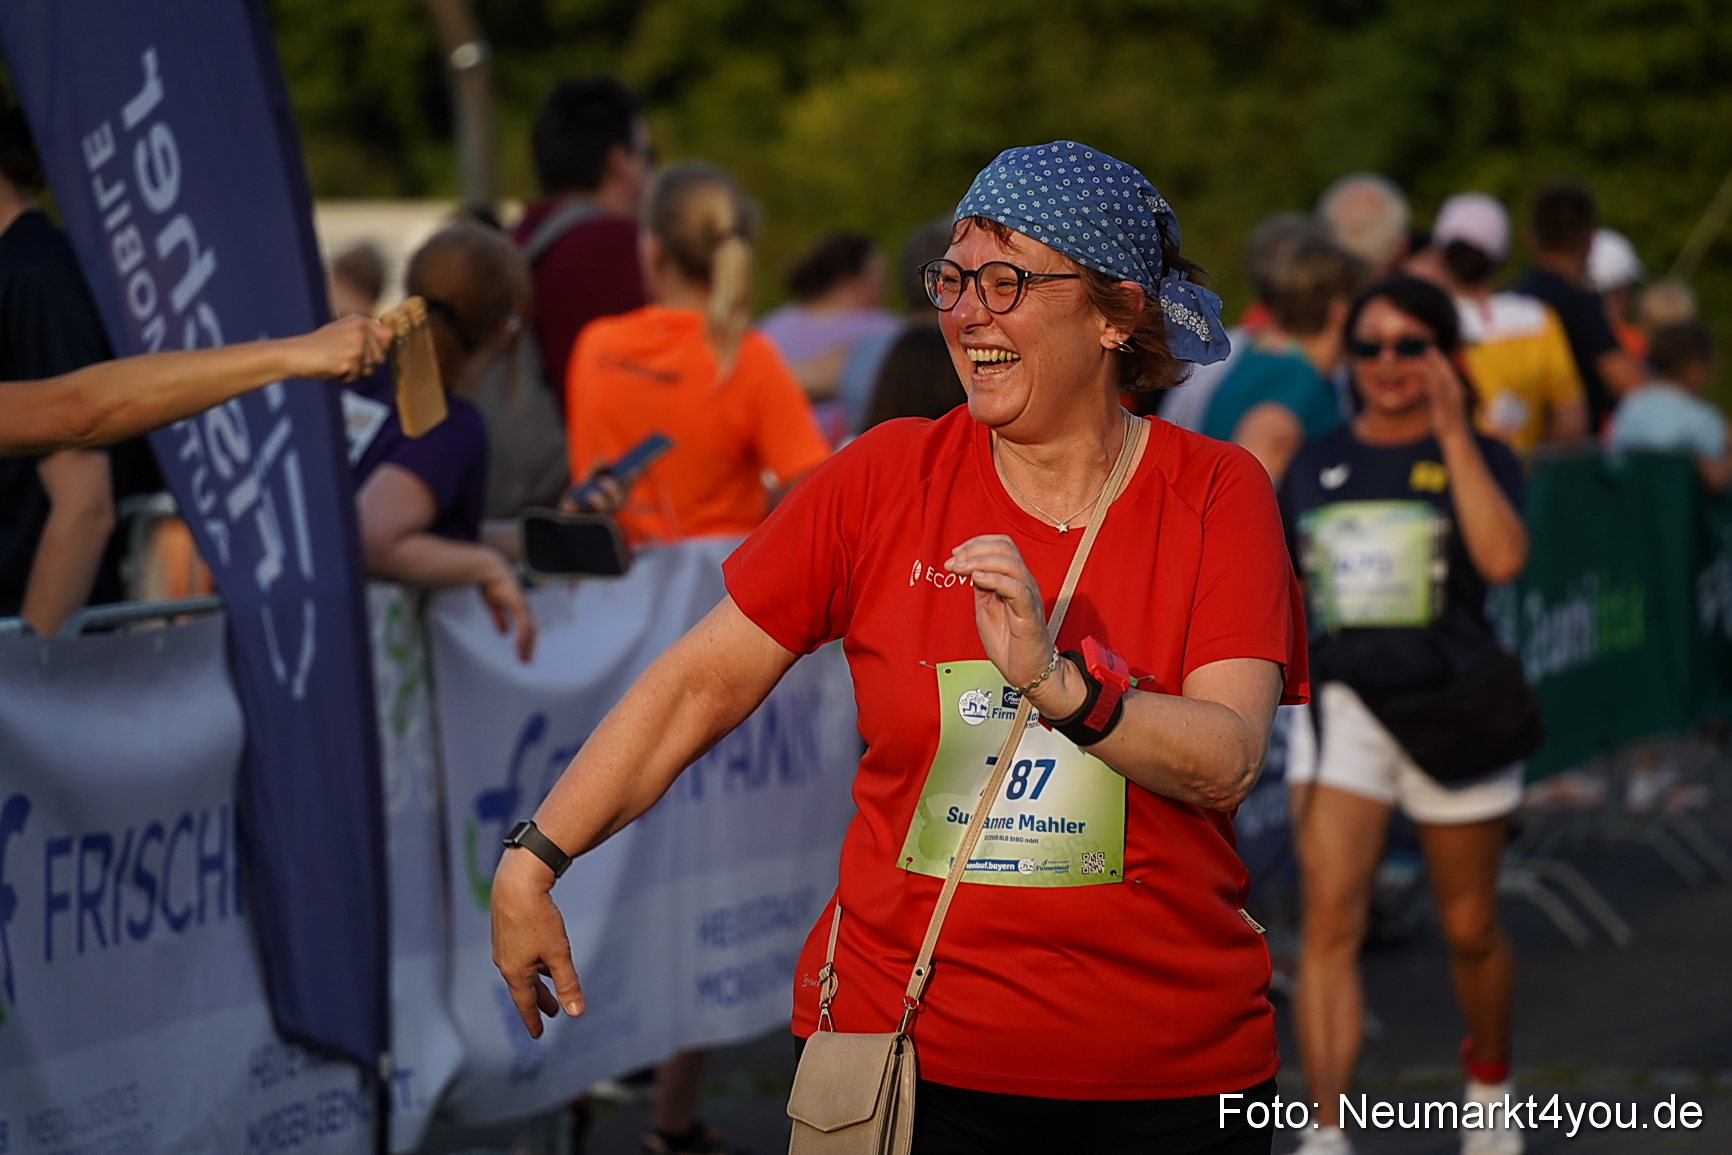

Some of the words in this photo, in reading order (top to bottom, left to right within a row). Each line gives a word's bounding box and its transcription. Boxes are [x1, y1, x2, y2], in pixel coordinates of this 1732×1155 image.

[946, 806, 1014, 830] Suanne
[1018, 813, 1086, 834] Mahler
[43, 803, 246, 963] FRISCH
